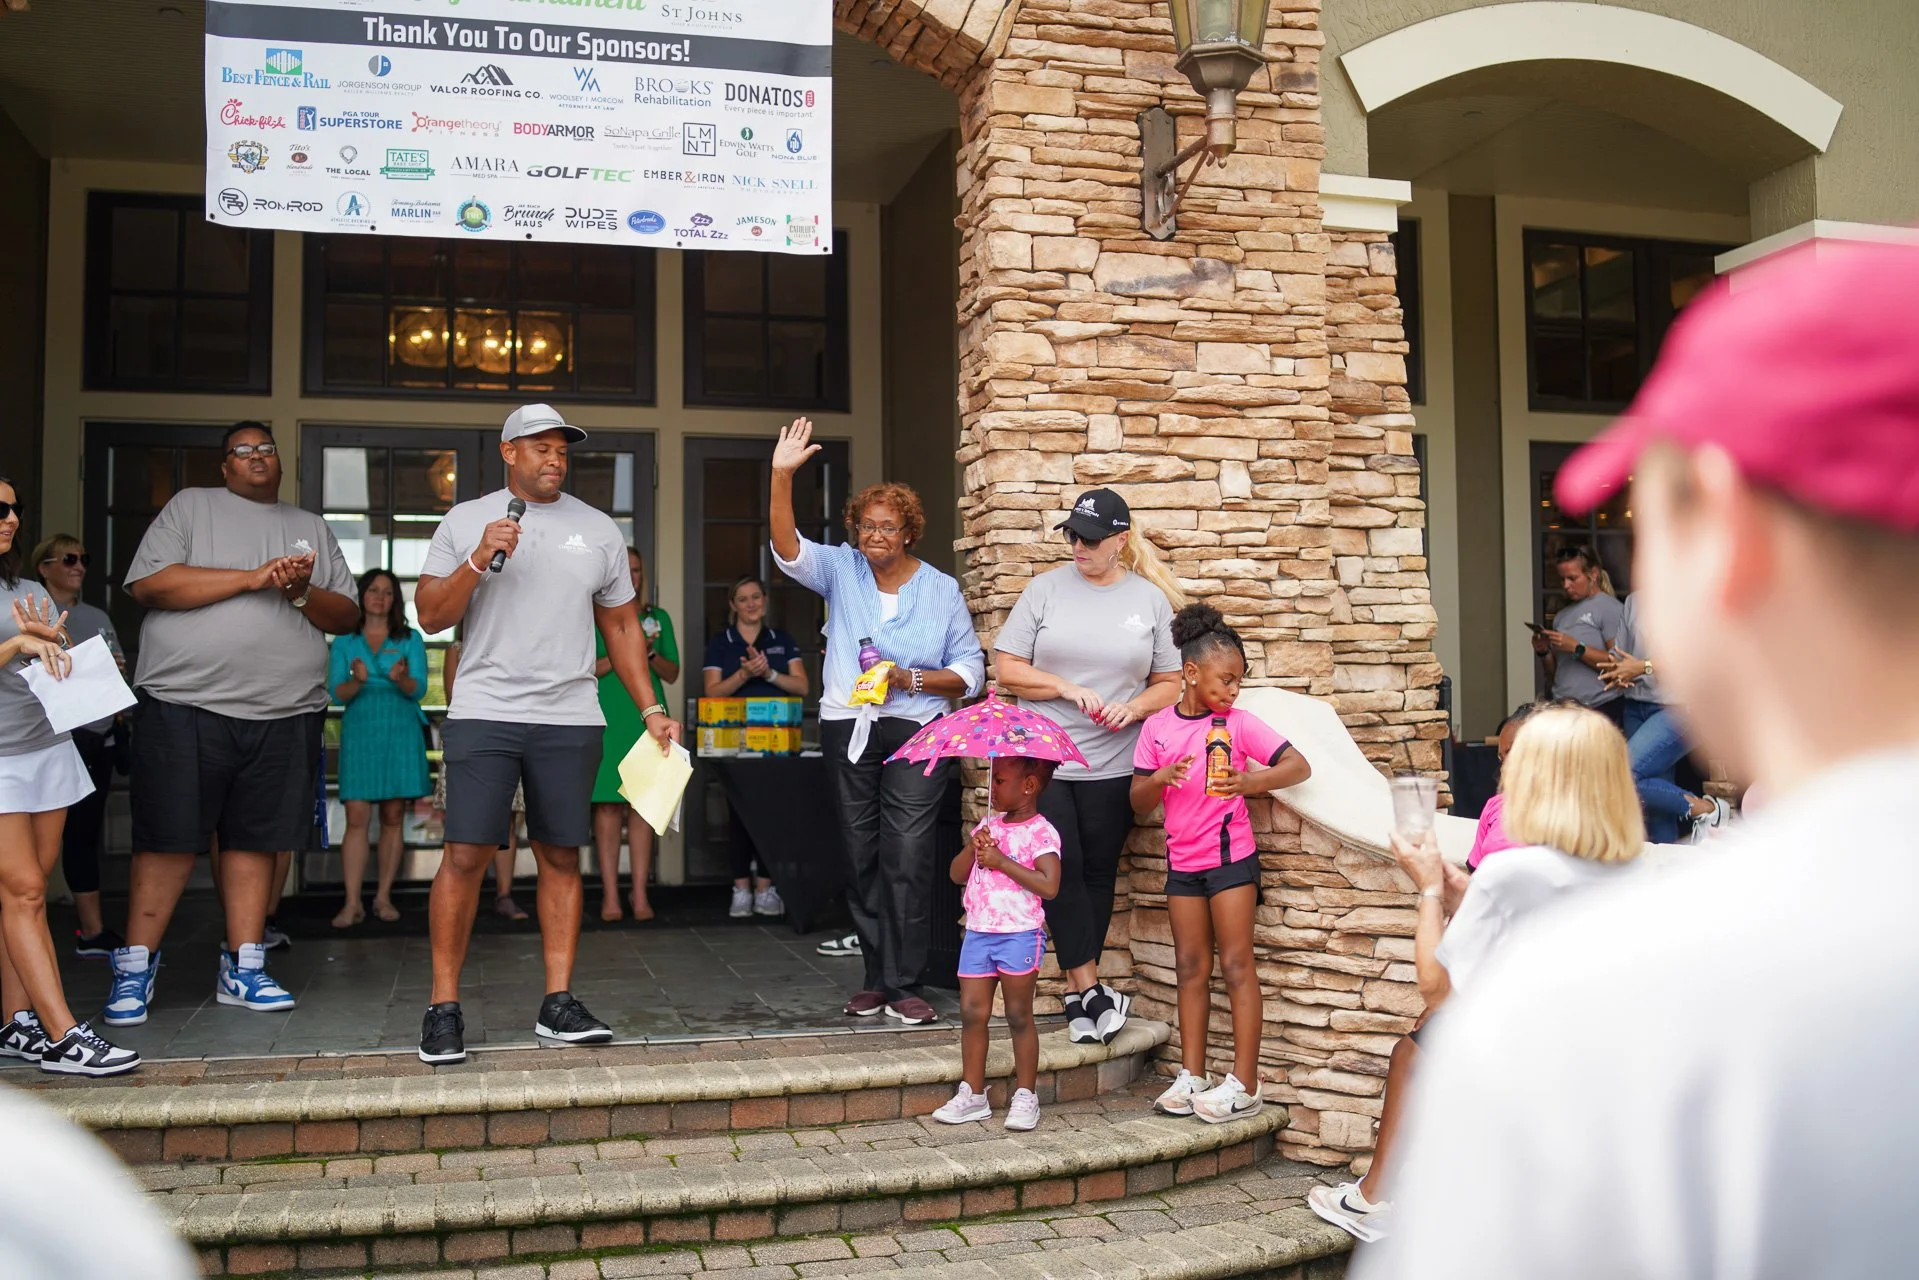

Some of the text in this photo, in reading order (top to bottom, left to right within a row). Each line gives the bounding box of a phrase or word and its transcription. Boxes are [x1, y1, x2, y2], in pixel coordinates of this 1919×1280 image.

[686, 6, 742, 23] JOHNS
[362, 16, 690, 62] Thank You To Our Sponsors!
[222, 66, 331, 88] BEST FENCE & RAIL
[338, 80, 422, 91] JORGENSON GROUP
[430, 84, 468, 94] VALOR
[471, 86, 521, 98] ROOFING
[524, 90, 544, 99] CO.
[634, 93, 712, 108] Rehabilitation
[724, 82, 803, 108] DONATOS
[724, 104, 745, 113] Every
[320, 118, 402, 129] SUPERSTORE
[414, 116, 501, 132] Orangetheory
[513, 122, 595, 138] BODYARMOR
[604, 126, 681, 142] SoNapa Grille
[720, 139, 774, 152] EDWIN WATTS
[390, 152, 426, 162] TATE'S
[736, 149, 757, 158] GOLF
[450, 156, 519, 172] AMARA
[526, 165, 632, 182] GOLFTEC
[732, 174, 818, 189] NICK SNELL
[392, 208, 431, 218] MARLIN
[504, 205, 555, 222] Brunch
[566, 207, 618, 220] DUDE
[566, 220, 618, 230] WIPES
[736, 216, 777, 226] JAMESON
[674, 228, 706, 238] TOTAL
